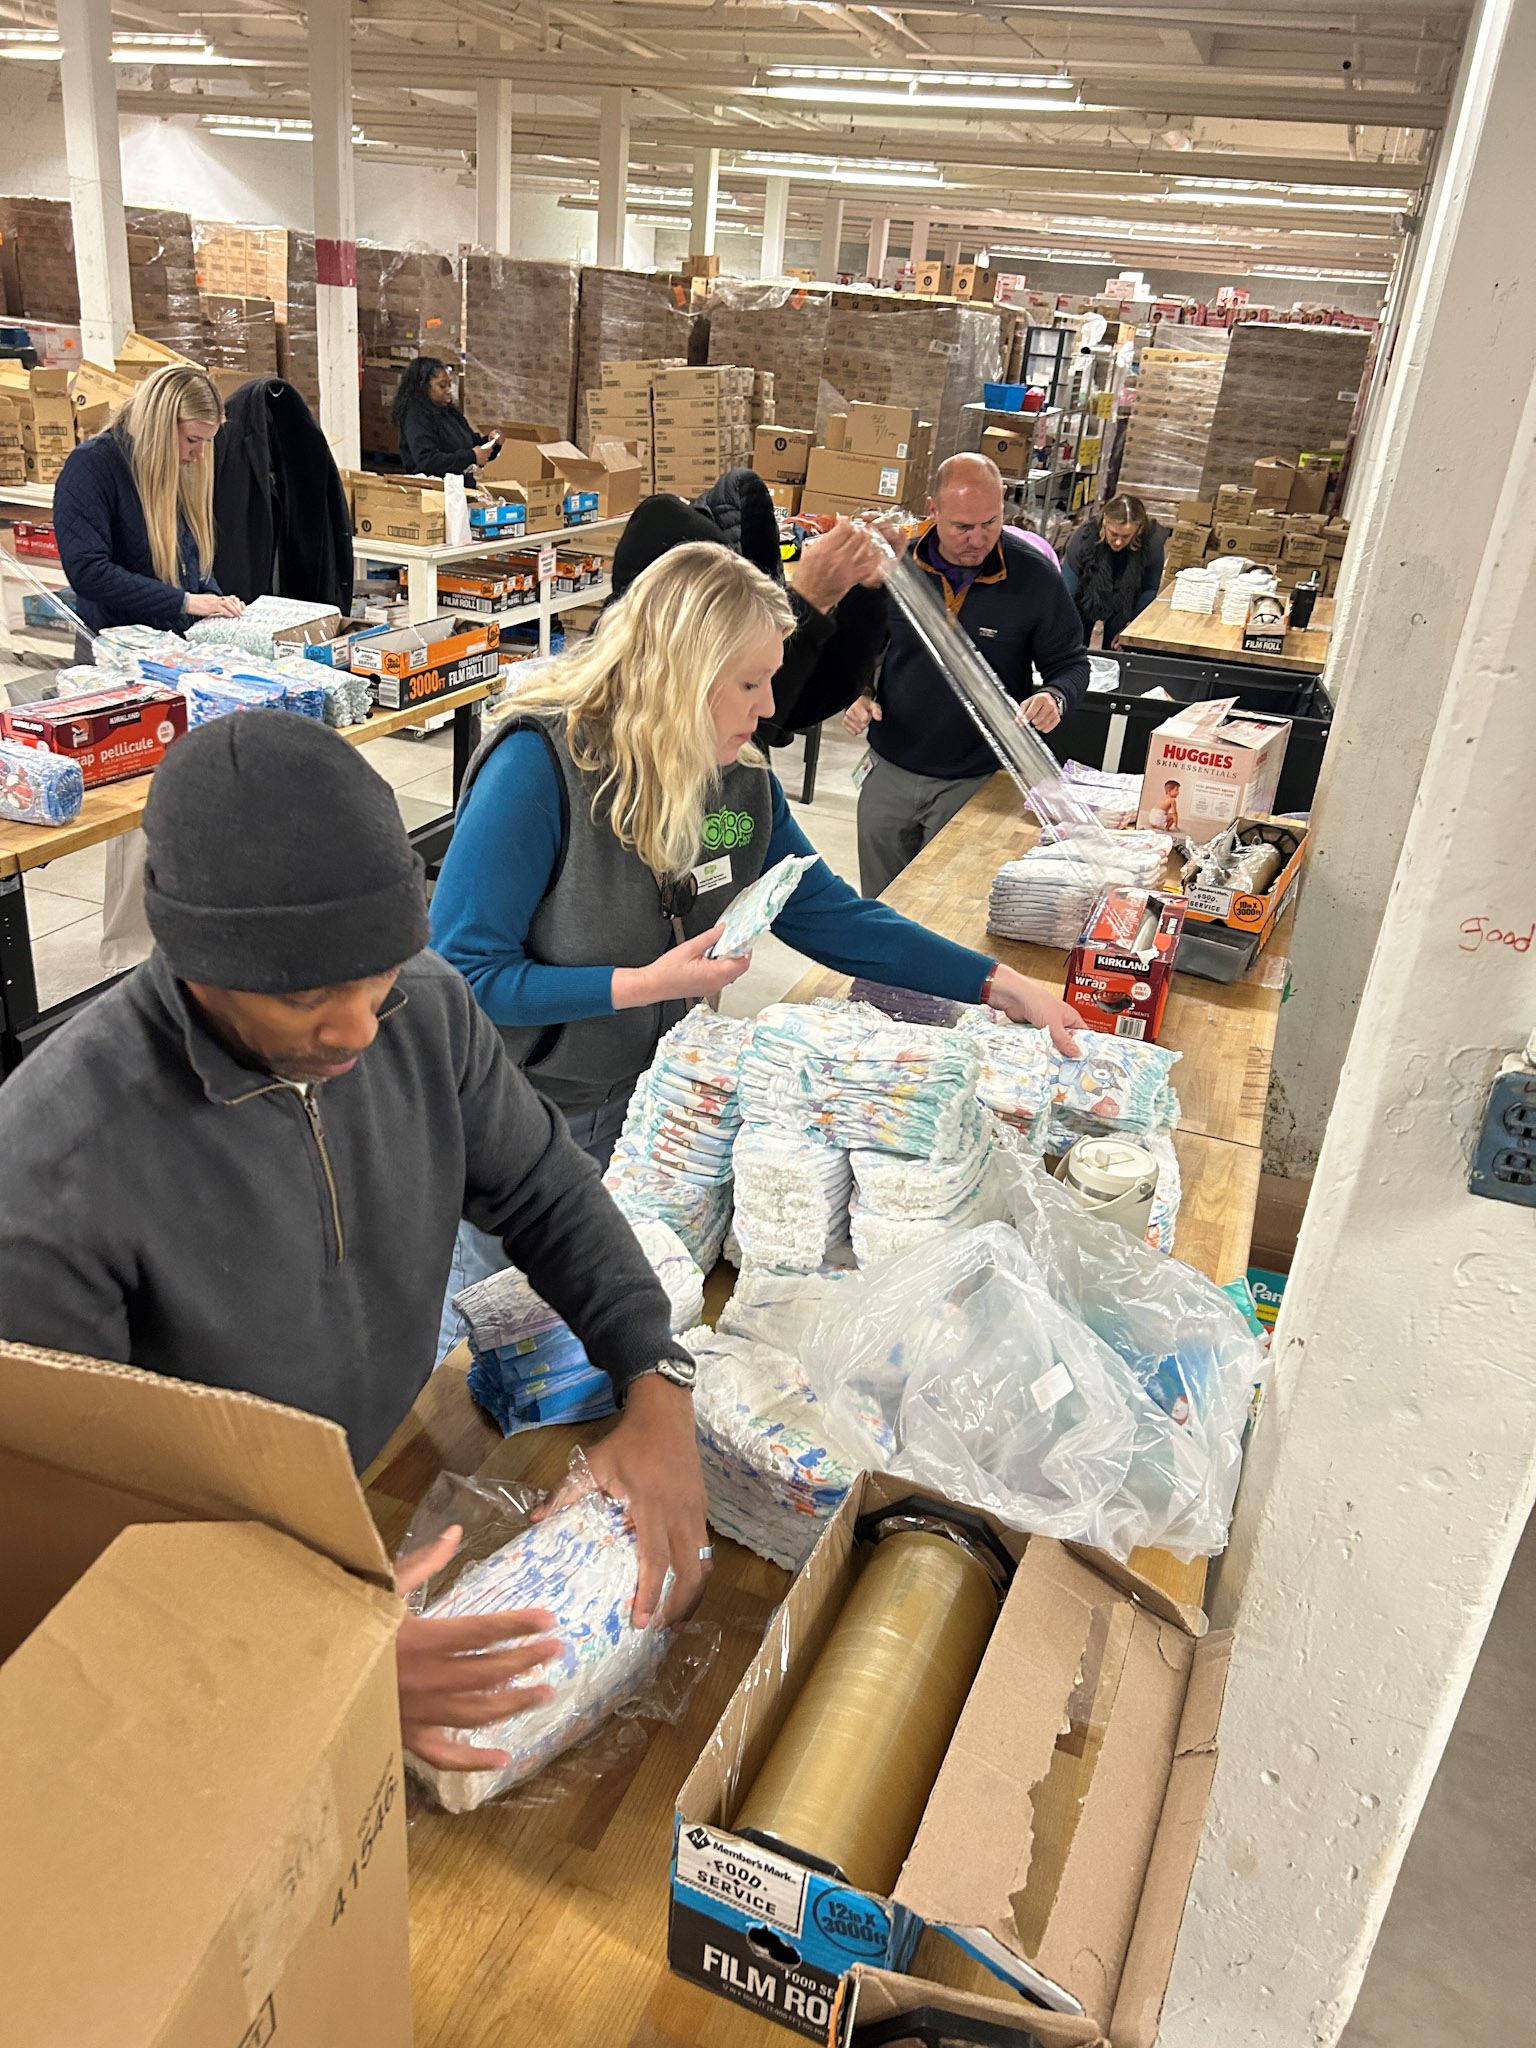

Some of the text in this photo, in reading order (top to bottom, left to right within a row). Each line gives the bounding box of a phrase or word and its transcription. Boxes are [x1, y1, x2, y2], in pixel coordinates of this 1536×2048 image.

[443, 596, 476, 609] FILM ROLL
[1245, 640, 1281, 650] FILM ROLL
[448, 668, 466, 687] FILM
[466, 663, 483, 680] ROLL
[100, 737, 154, 763] pellicule
[1163, 744, 1233, 769] HUGGIES
[1156, 759, 1238, 779] SKIN ESSENTIALS
[1190, 901, 1221, 912] SERVICE
[1098, 955, 1150, 973] KIRKLAND
[1075, 976, 1107, 991] wrap
[713, 1841, 792, 1884] Member's Mark
[713, 1859, 763, 1889] FOOD
[697, 1870, 777, 1916] SERVICE
[702, 1943, 777, 2003] FILM
[783, 1983, 834, 2029] RO
[785, 1969, 817, 1991] FOOD
